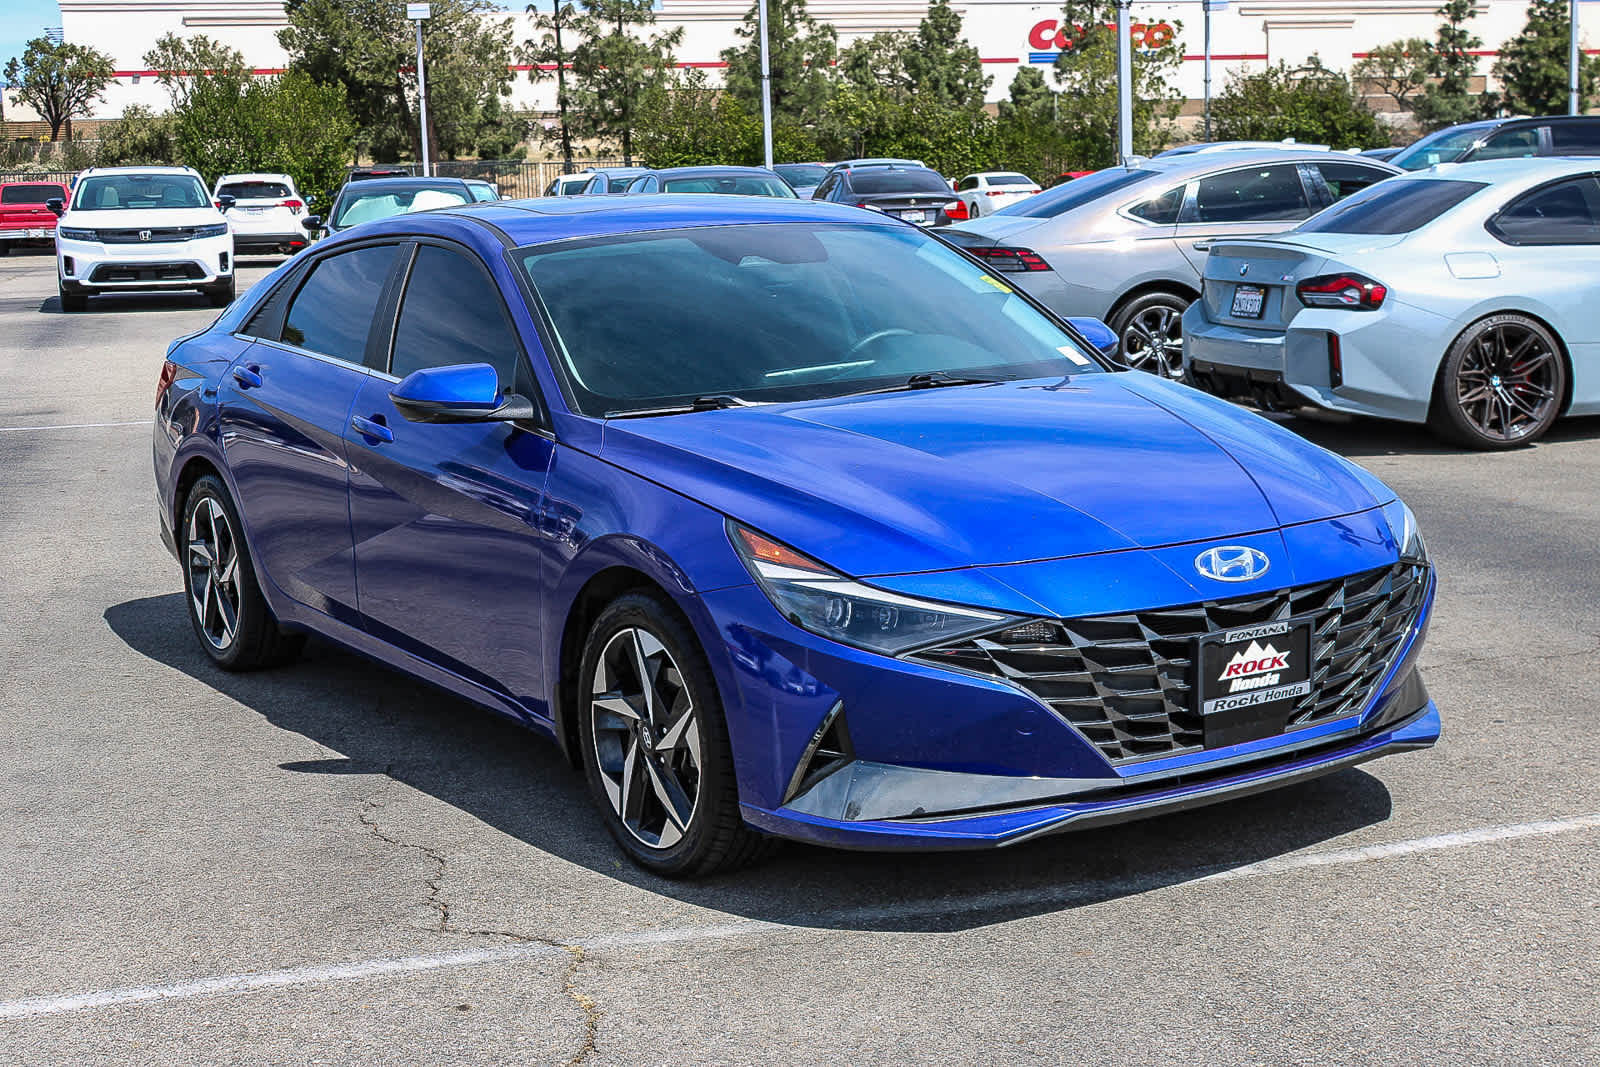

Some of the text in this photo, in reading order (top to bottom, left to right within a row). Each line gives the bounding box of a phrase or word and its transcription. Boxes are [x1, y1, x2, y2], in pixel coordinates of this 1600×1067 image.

[1230, 623, 1286, 641] FONTANA
[1226, 655, 1285, 677] ROCK
[1213, 685, 1303, 711] Rock Honda
